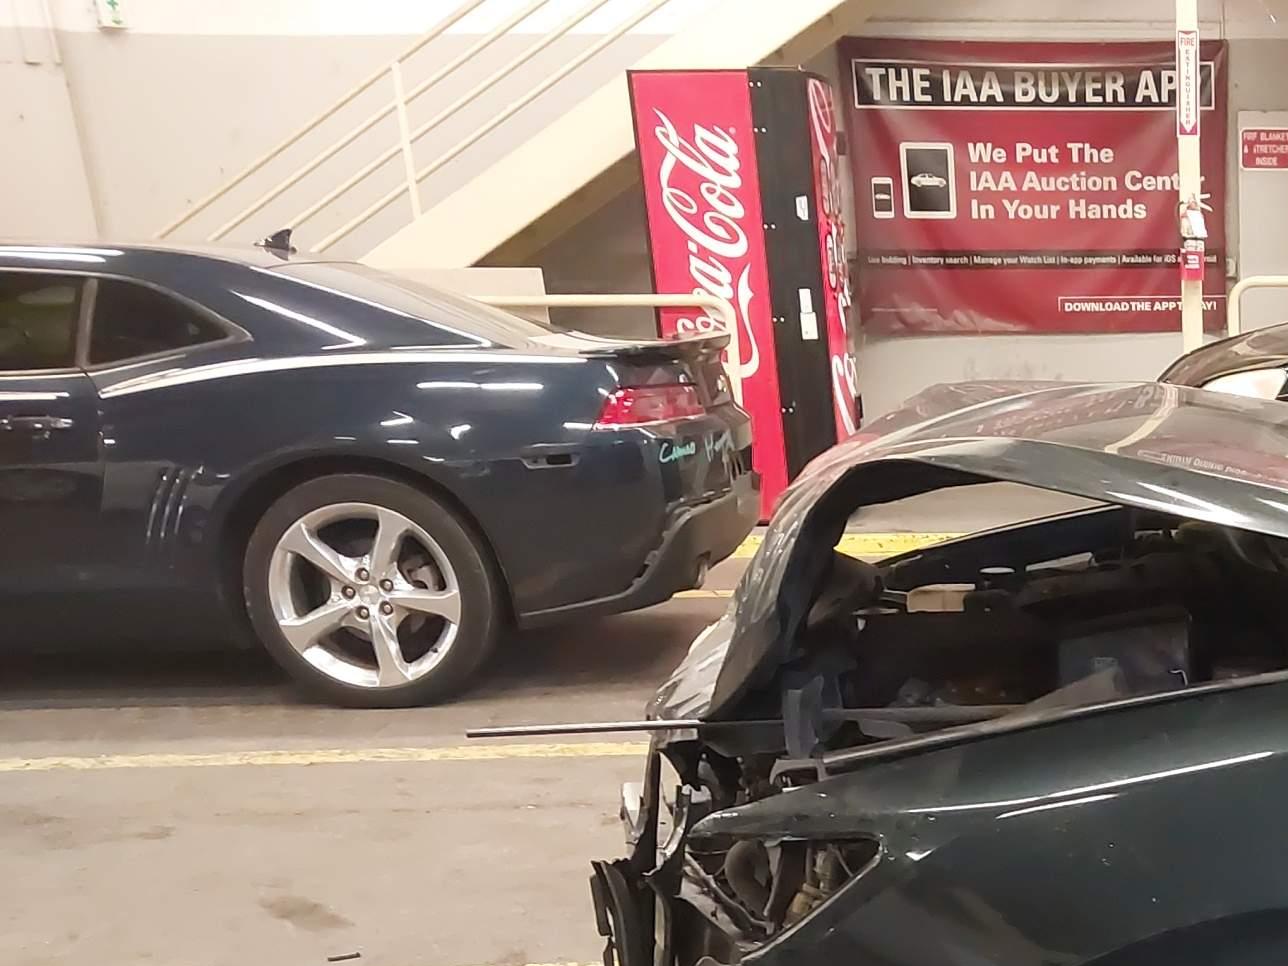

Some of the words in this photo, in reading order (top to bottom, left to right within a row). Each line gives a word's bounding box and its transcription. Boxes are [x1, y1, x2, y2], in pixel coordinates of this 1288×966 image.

[1180, 37, 1195, 47] FIRE
[865, 67, 932, 102] THE
[942, 69, 1005, 103] IAA
[1014, 70, 1118, 103] BUYER
[1135, 70, 1202, 104] AP
[1243, 132, 1257, 141] FIRE
[968, 143, 1006, 164] We
[1015, 143, 1059, 164] Put
[1067, 143, 1114, 164] The
[1255, 157, 1278, 166] INSIDE
[970, 171, 1017, 192] IAA
[1022, 171, 1118, 192] Auction
[1124, 171, 1205, 192] Cent
[971, 199, 995, 220] In
[1001, 199, 1060, 220] Your
[1069, 199, 1147, 220] Hands
[912, 255, 944, 265] Inventory
[945, 255, 969, 264] search
[973, 255, 1002, 266] Manage
[1002, 257, 1018, 266] your
[1019, 255, 1042, 265] Watch
[1043, 255, 1055, 265] List
[1061, 255, 1083, 265] In-app
[1084, 256, 1117, 265] payments
[1121, 255, 1152, 264] Available
[1153, 255, 1162, 264] for
[1164, 254, 1177, 264] iOS
[1064, 301, 1130, 312] DOWNLOAD
[1131, 301, 1152, 311] THE
[1153, 301, 1177, 311] APP
[1177, 301, 1217, 311] TAY!
